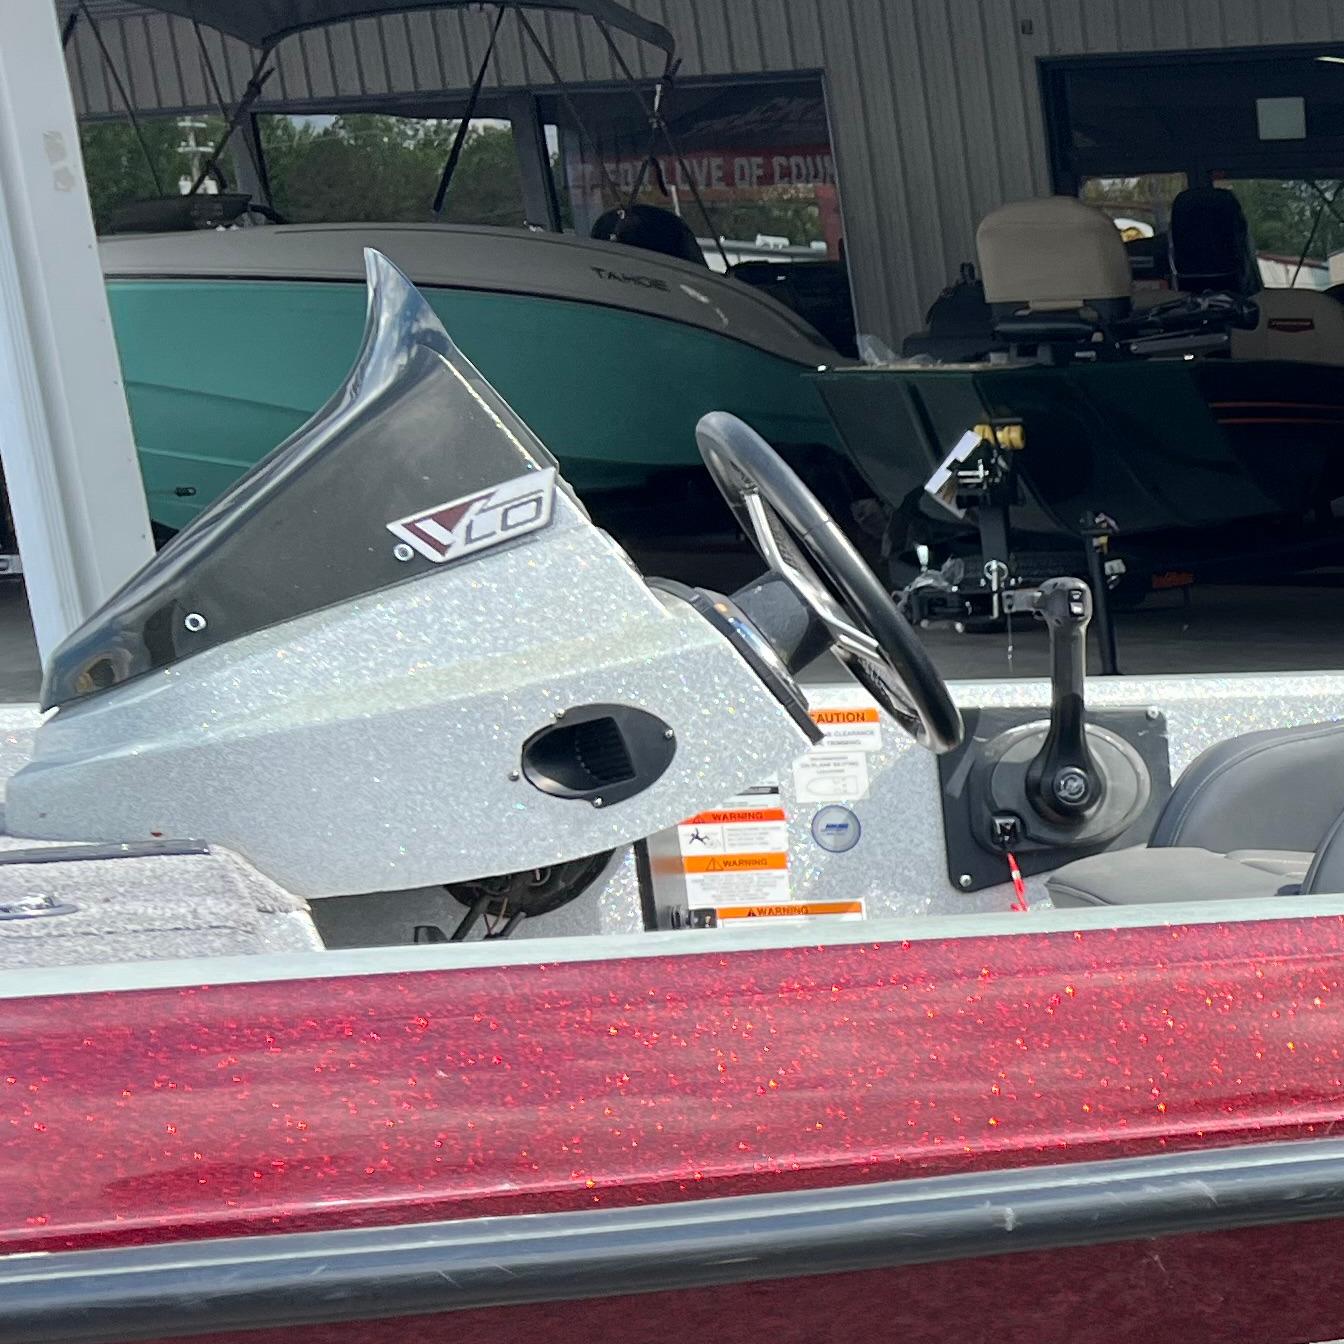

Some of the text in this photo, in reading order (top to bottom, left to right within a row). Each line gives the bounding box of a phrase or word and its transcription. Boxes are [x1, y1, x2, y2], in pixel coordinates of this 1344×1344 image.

[734, 157, 763, 190] OF
[590, 265, 671, 292] TAHOE
[809, 711, 866, 723] AUTION
[711, 811, 764, 821] WARNING
[722, 857, 768, 868] WARNING
[757, 905, 809, 916] WARNING
